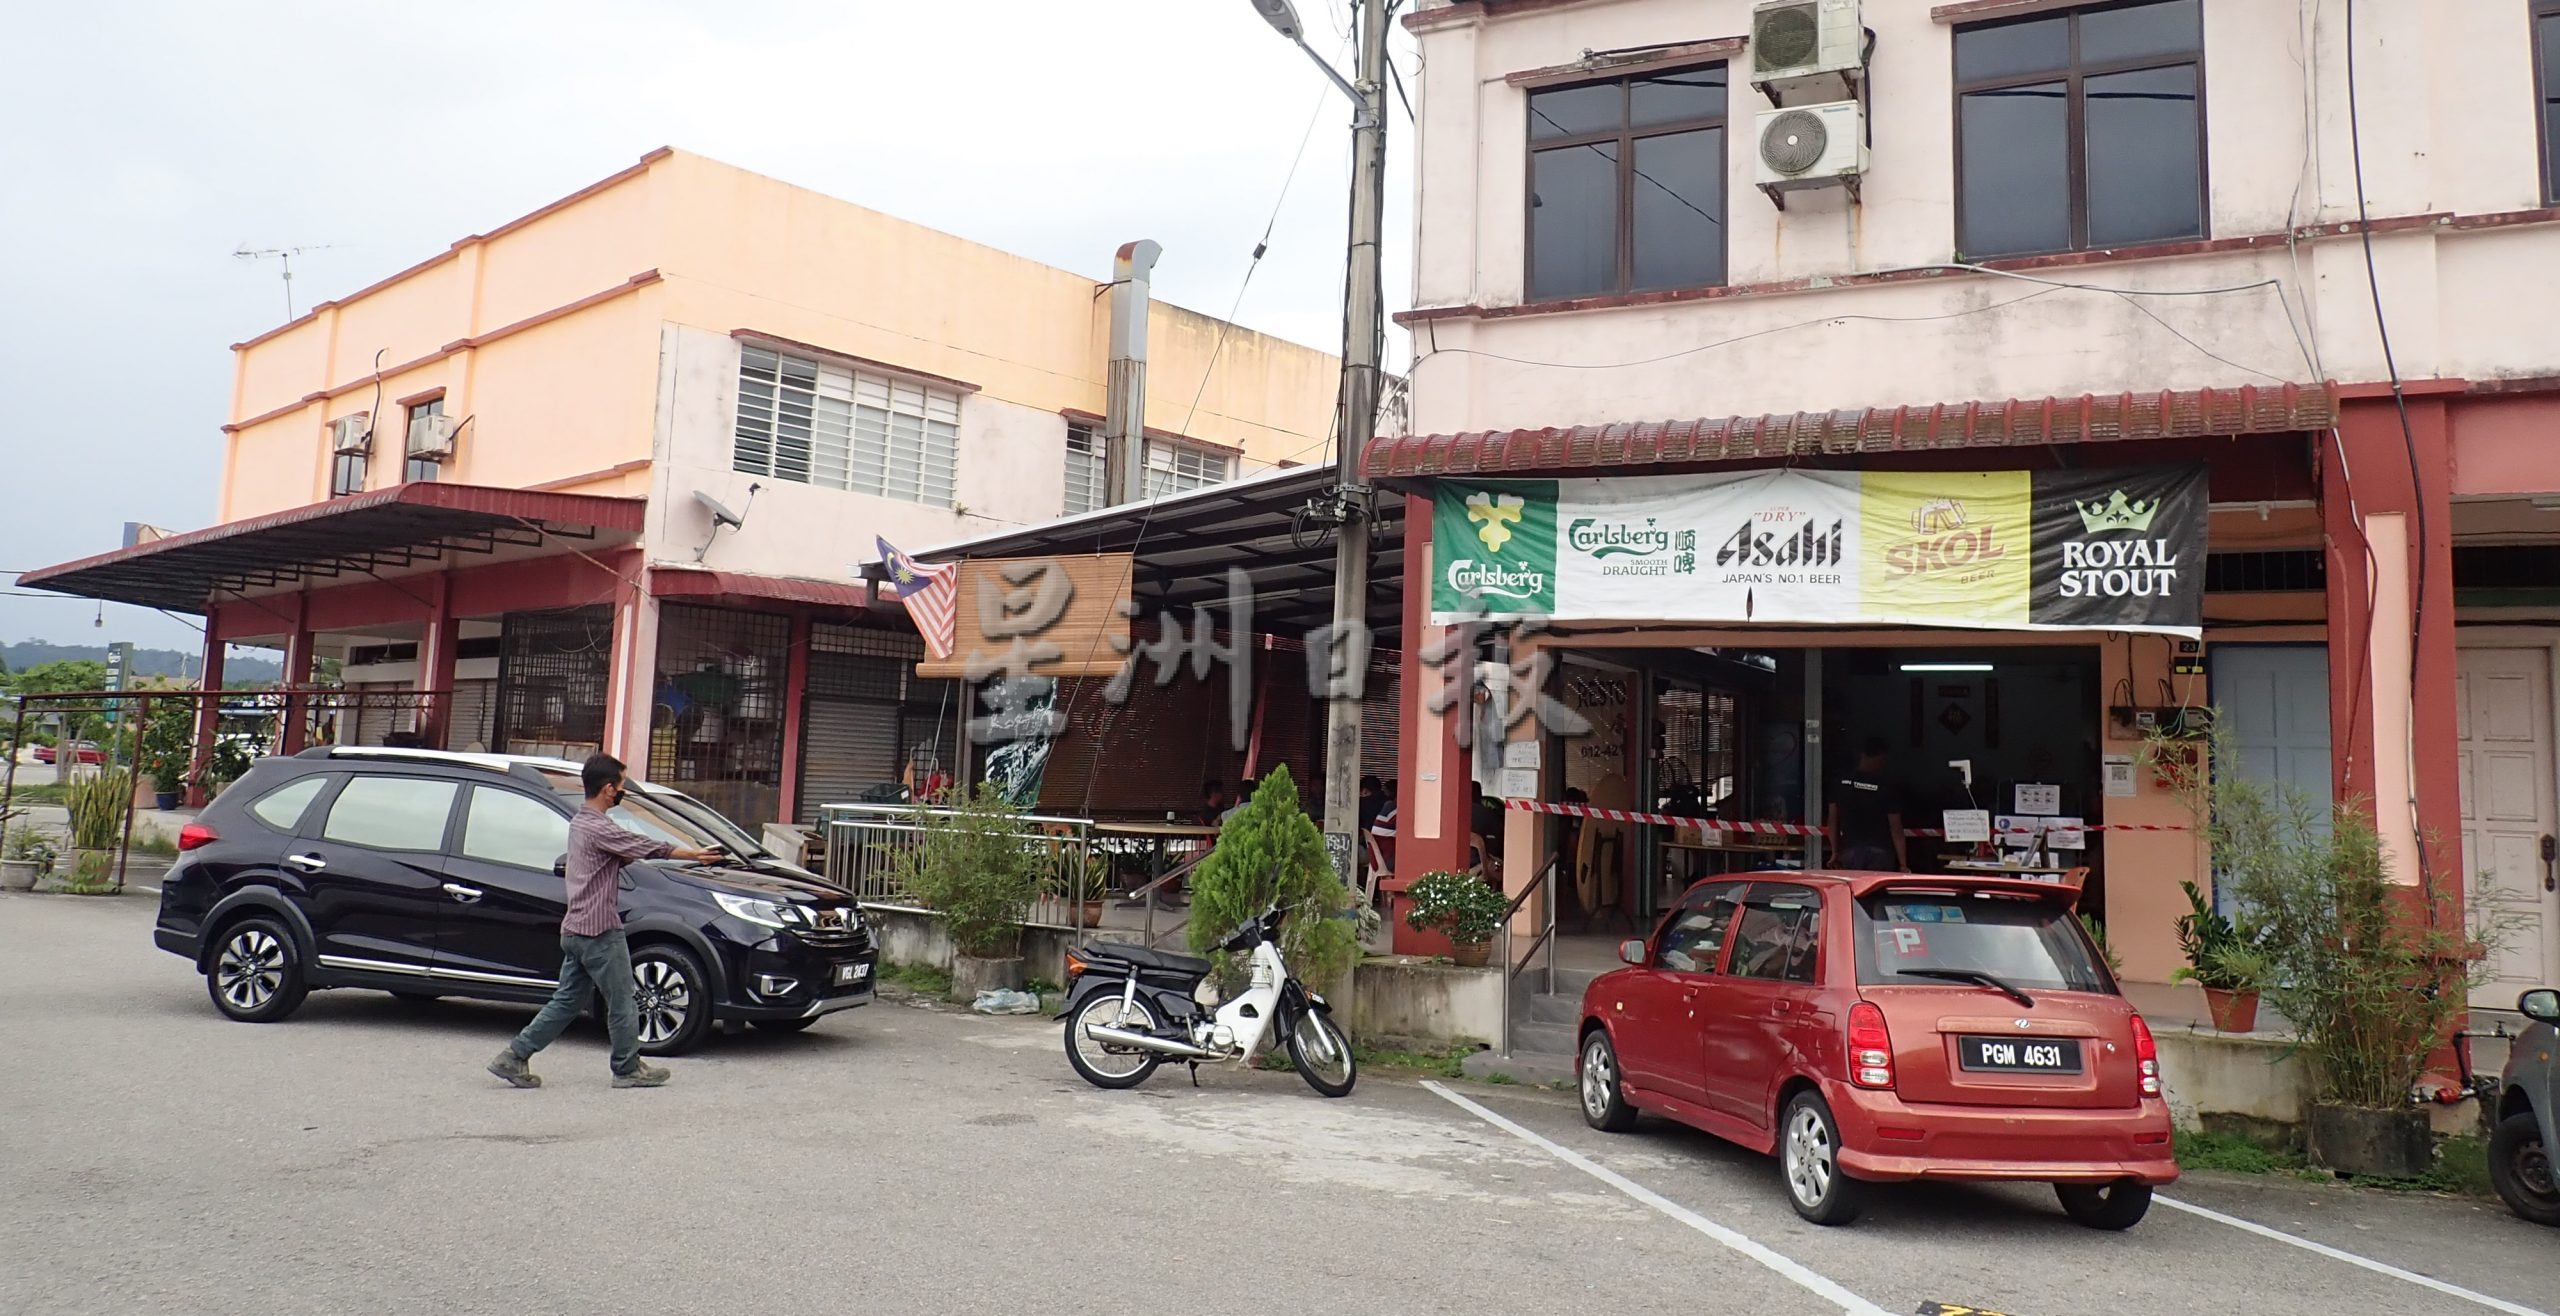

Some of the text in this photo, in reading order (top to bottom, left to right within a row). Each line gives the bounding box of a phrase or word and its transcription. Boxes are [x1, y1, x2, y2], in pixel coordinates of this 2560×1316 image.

[1568, 518, 1668, 559] Carlsberg
[1674, 529, 1696, 575] 顺啤
[1716, 518, 1842, 567] Asahi
[1885, 525, 2005, 578] SKOL
[2062, 539, 2177, 568] ROYAL
[1448, 559, 1543, 598] Carlsberg
[1602, 566, 1667, 576] DRAUGHT
[1722, 573, 1841, 584] JAPAN'S NO.1 BEER
[1961, 569, 1995, 584] BEER
[2060, 568, 2177, 597] STOUT
[2182, 643, 2196, 651] 23
[1895, 928, 1921, 953] P
[1981, 1043, 2062, 1067] PGM 4631
